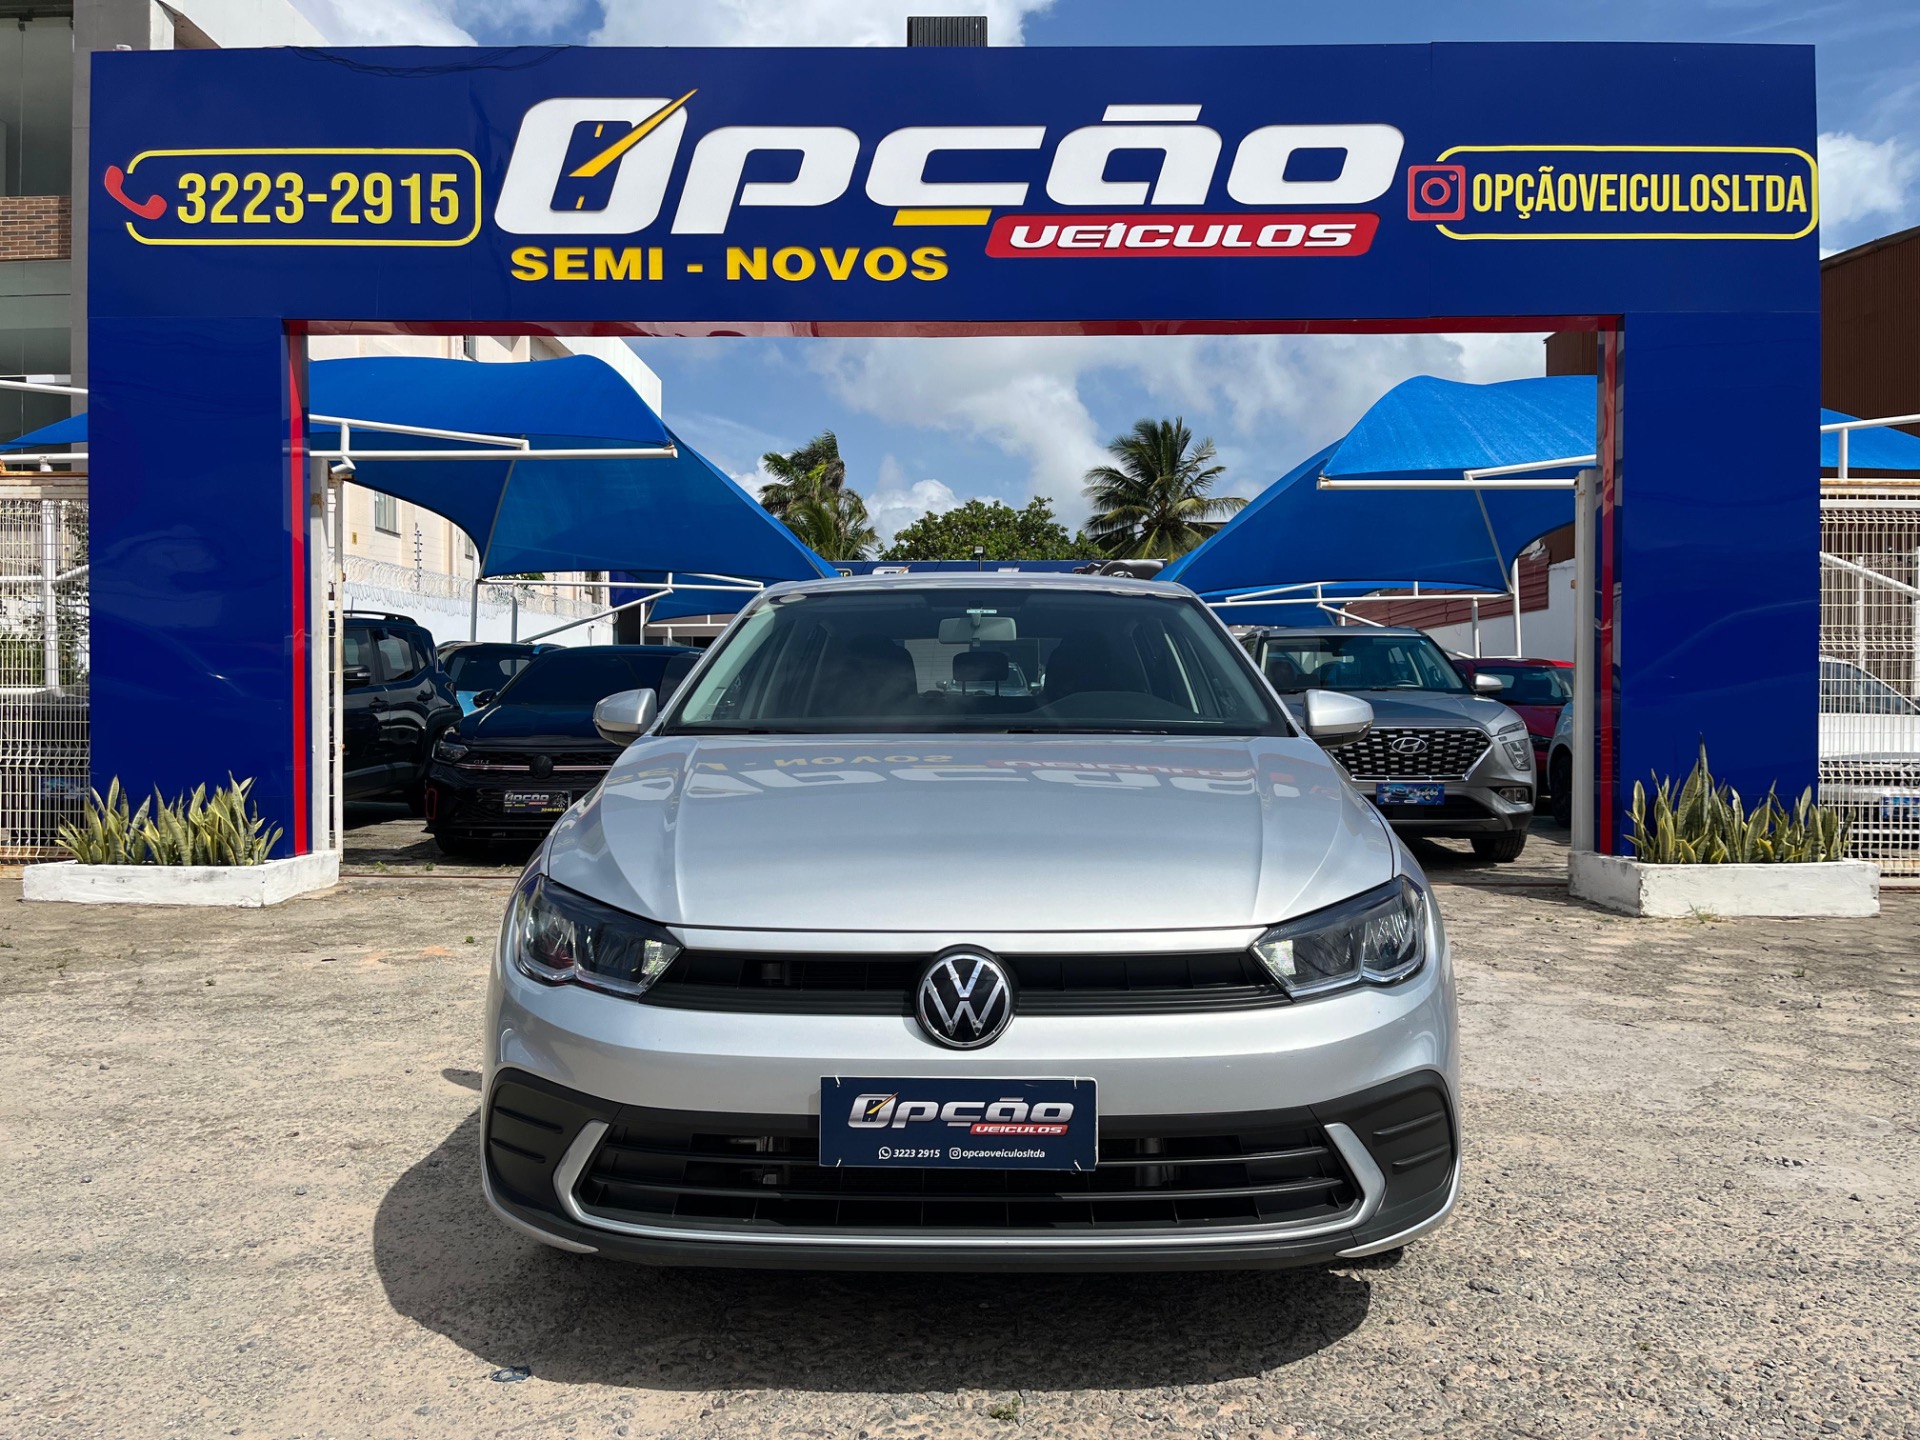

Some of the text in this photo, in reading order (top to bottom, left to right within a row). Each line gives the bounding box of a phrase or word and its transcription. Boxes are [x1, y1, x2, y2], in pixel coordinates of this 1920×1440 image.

[177, 172, 459, 225] 3223-2915
[1472, 165, 1808, 220] OPÇÃOVEICULOSLTDA
[511, 246, 663, 281] SEMI
[726, 246, 949, 282] NOVOS
[893, 1148, 1046, 1160] 3223 2915 opcaoveiculosltda
